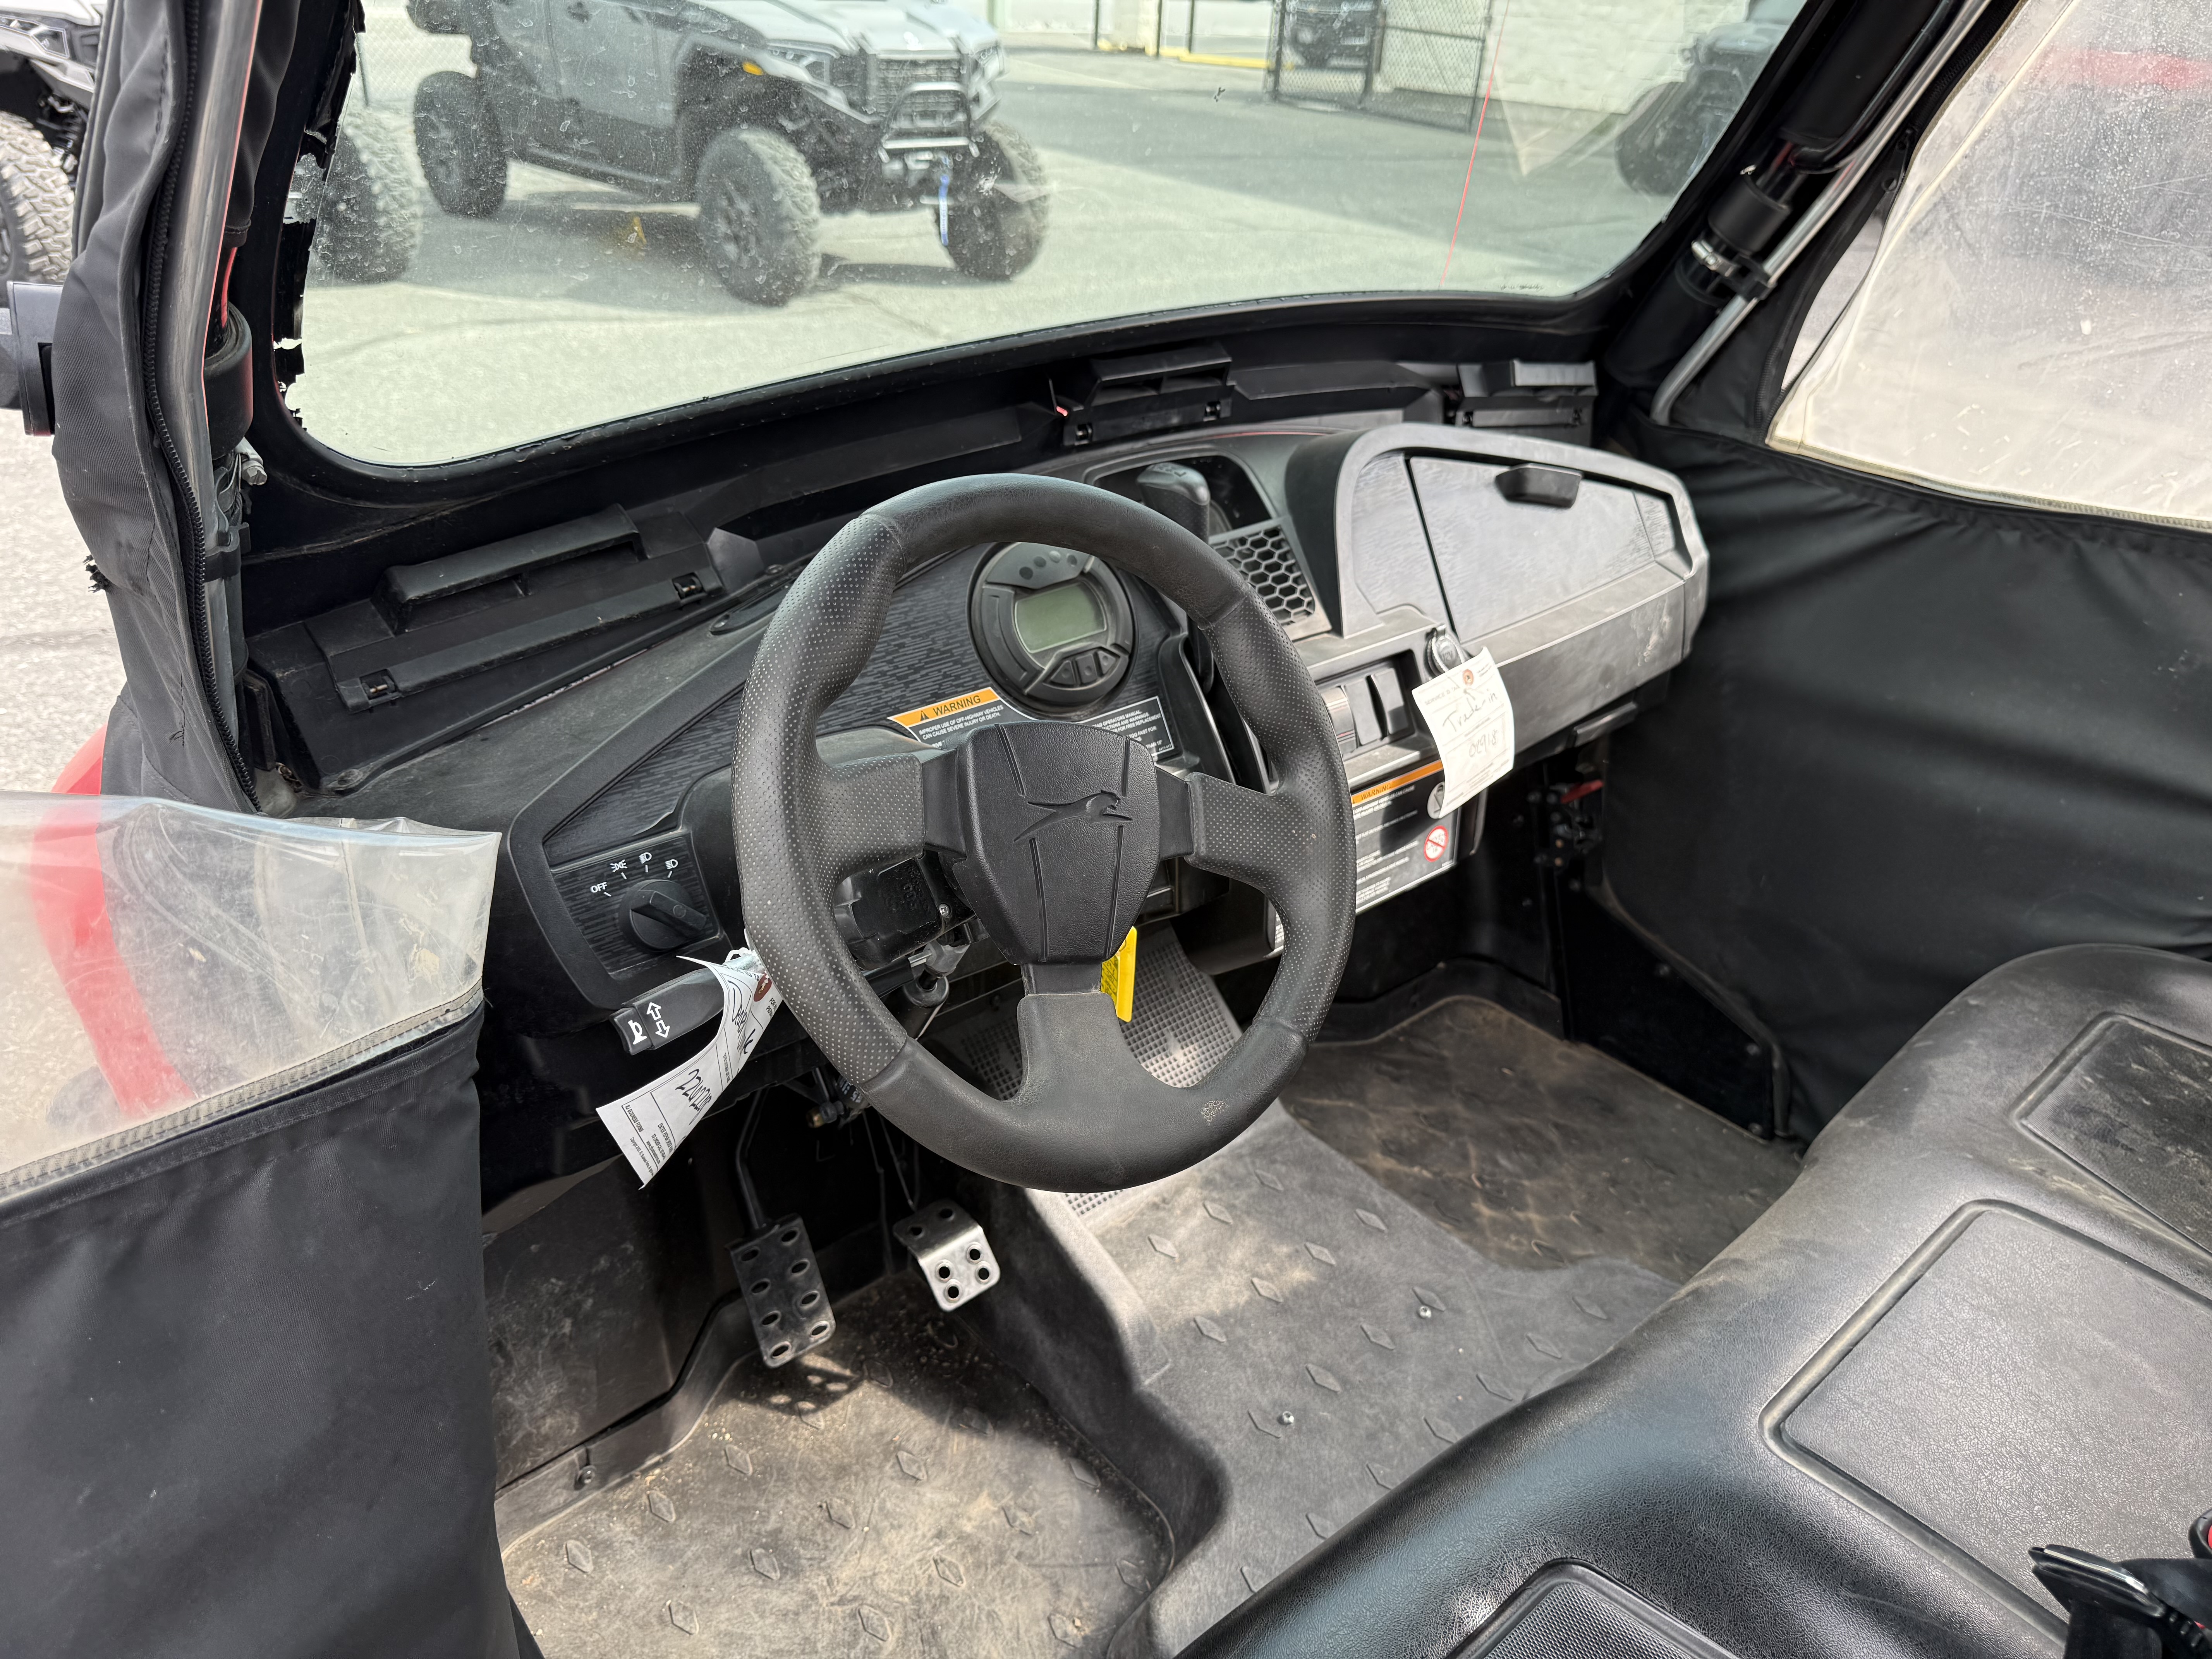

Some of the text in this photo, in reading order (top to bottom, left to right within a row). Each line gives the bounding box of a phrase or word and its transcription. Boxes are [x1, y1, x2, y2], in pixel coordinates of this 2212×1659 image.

[933, 695, 981, 716] WARNING
[919, 724, 941, 735] IMPROPER
[956, 711, 984, 723] OFF-HIGHWAY
[983, 704, 1003, 714] VEHICLES
[932, 728, 947, 737] CAUSE
[946, 723, 964, 732] SEVERE
[964, 718, 979, 726] INJURY
[985, 711, 1000, 720] DEATH.
[1361, 784, 1392, 800] WARNING
[590, 881, 608, 893] OFF
